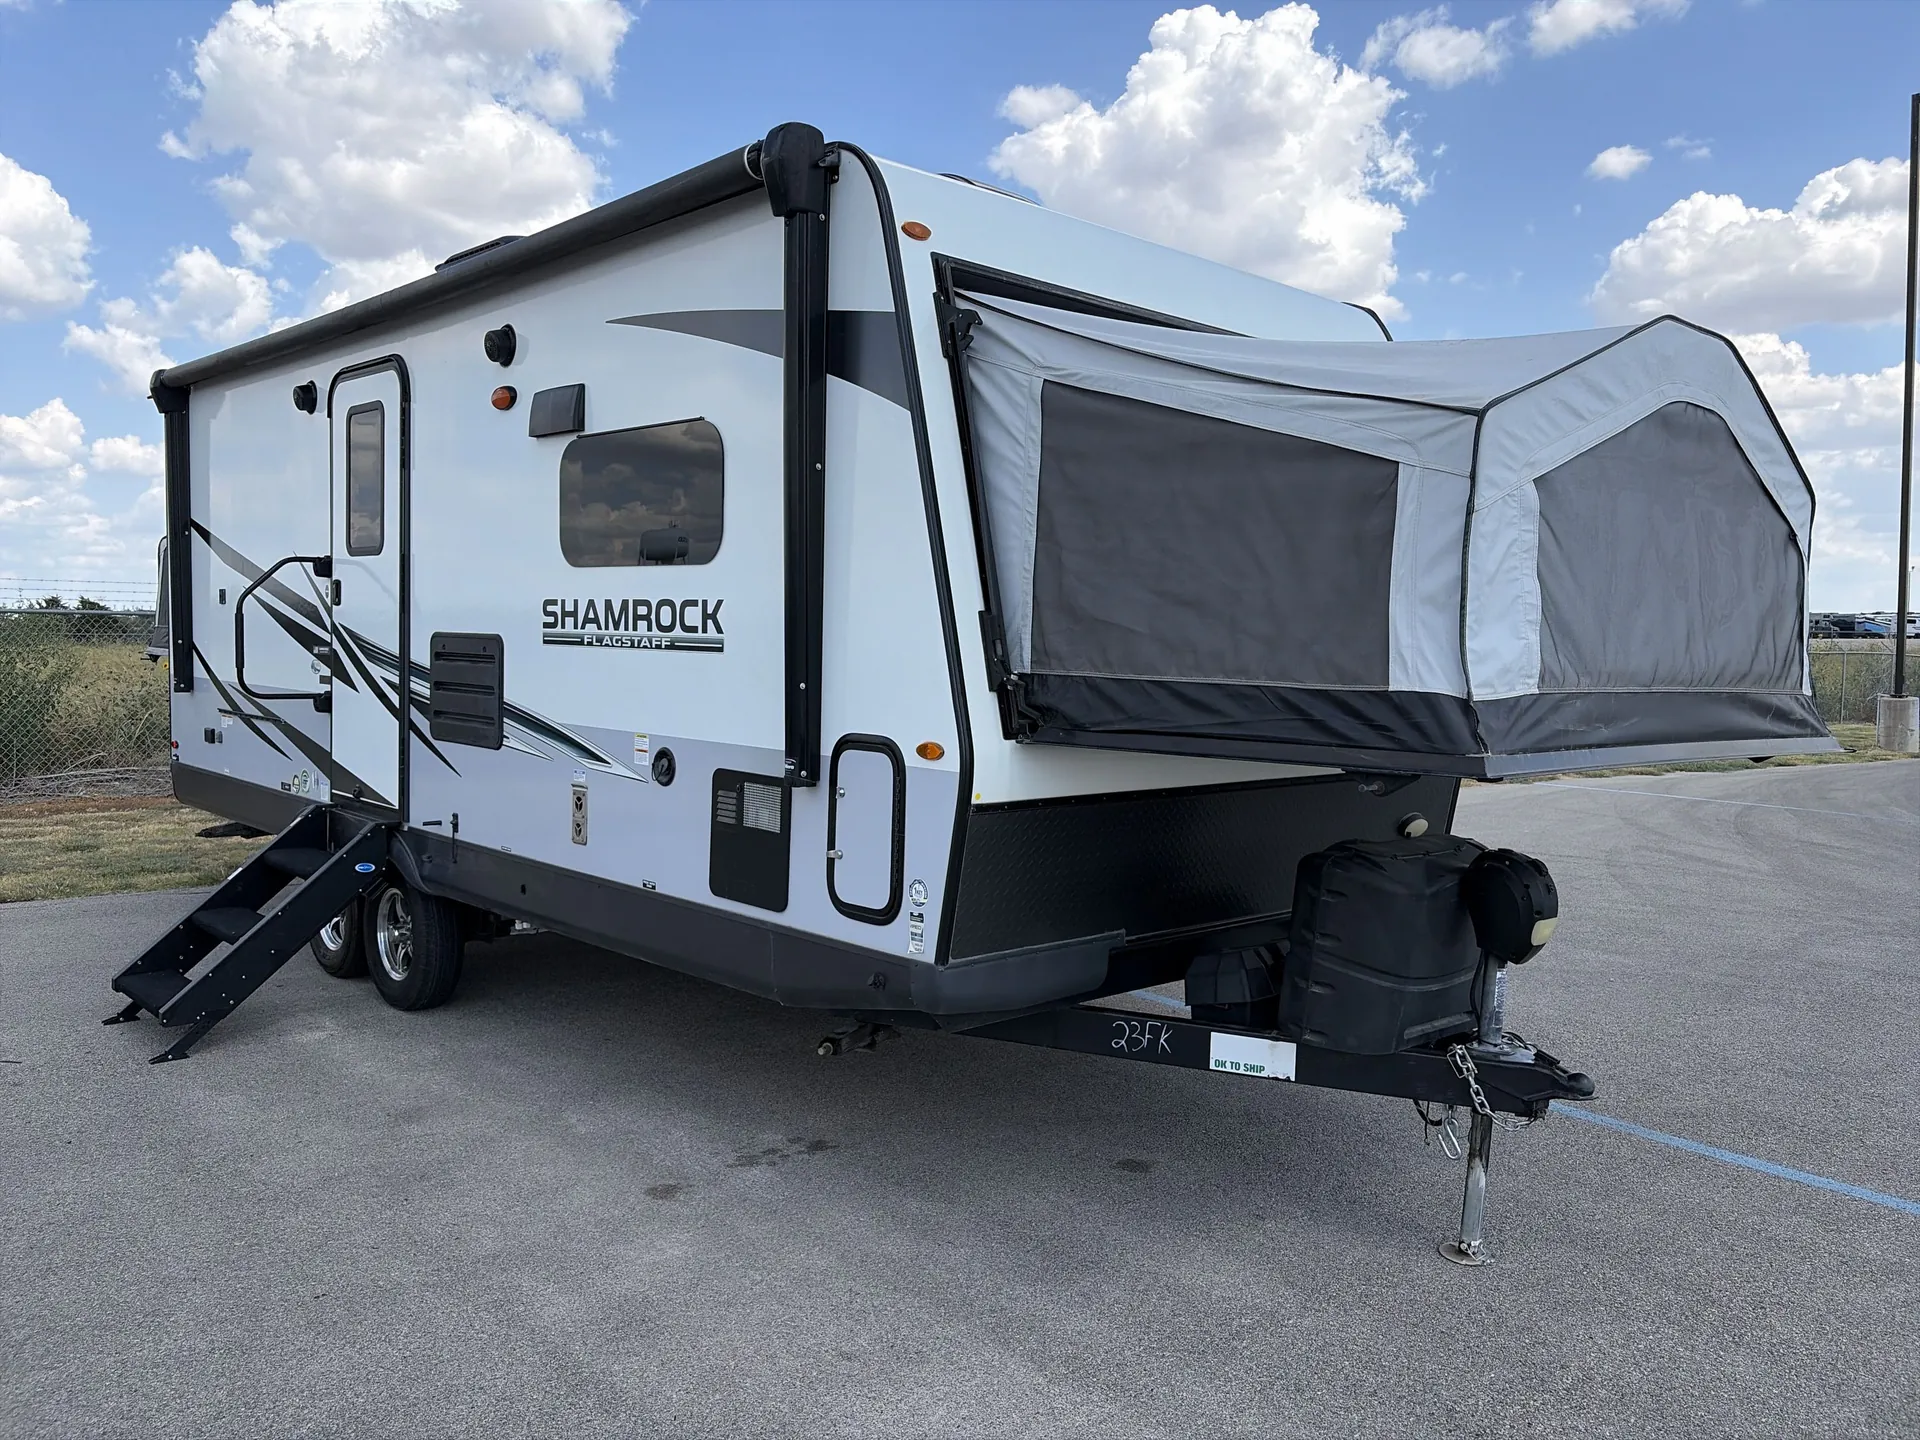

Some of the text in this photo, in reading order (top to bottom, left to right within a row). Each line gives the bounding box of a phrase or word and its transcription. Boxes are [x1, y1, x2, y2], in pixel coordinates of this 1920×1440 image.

[542, 598, 725, 635] SHAMROCK
[583, 634, 671, 649] FLAGSTAFF
[1111, 1021, 1173, 1054] 23FK
[1214, 1058, 1266, 1074] OK TO SHIP
